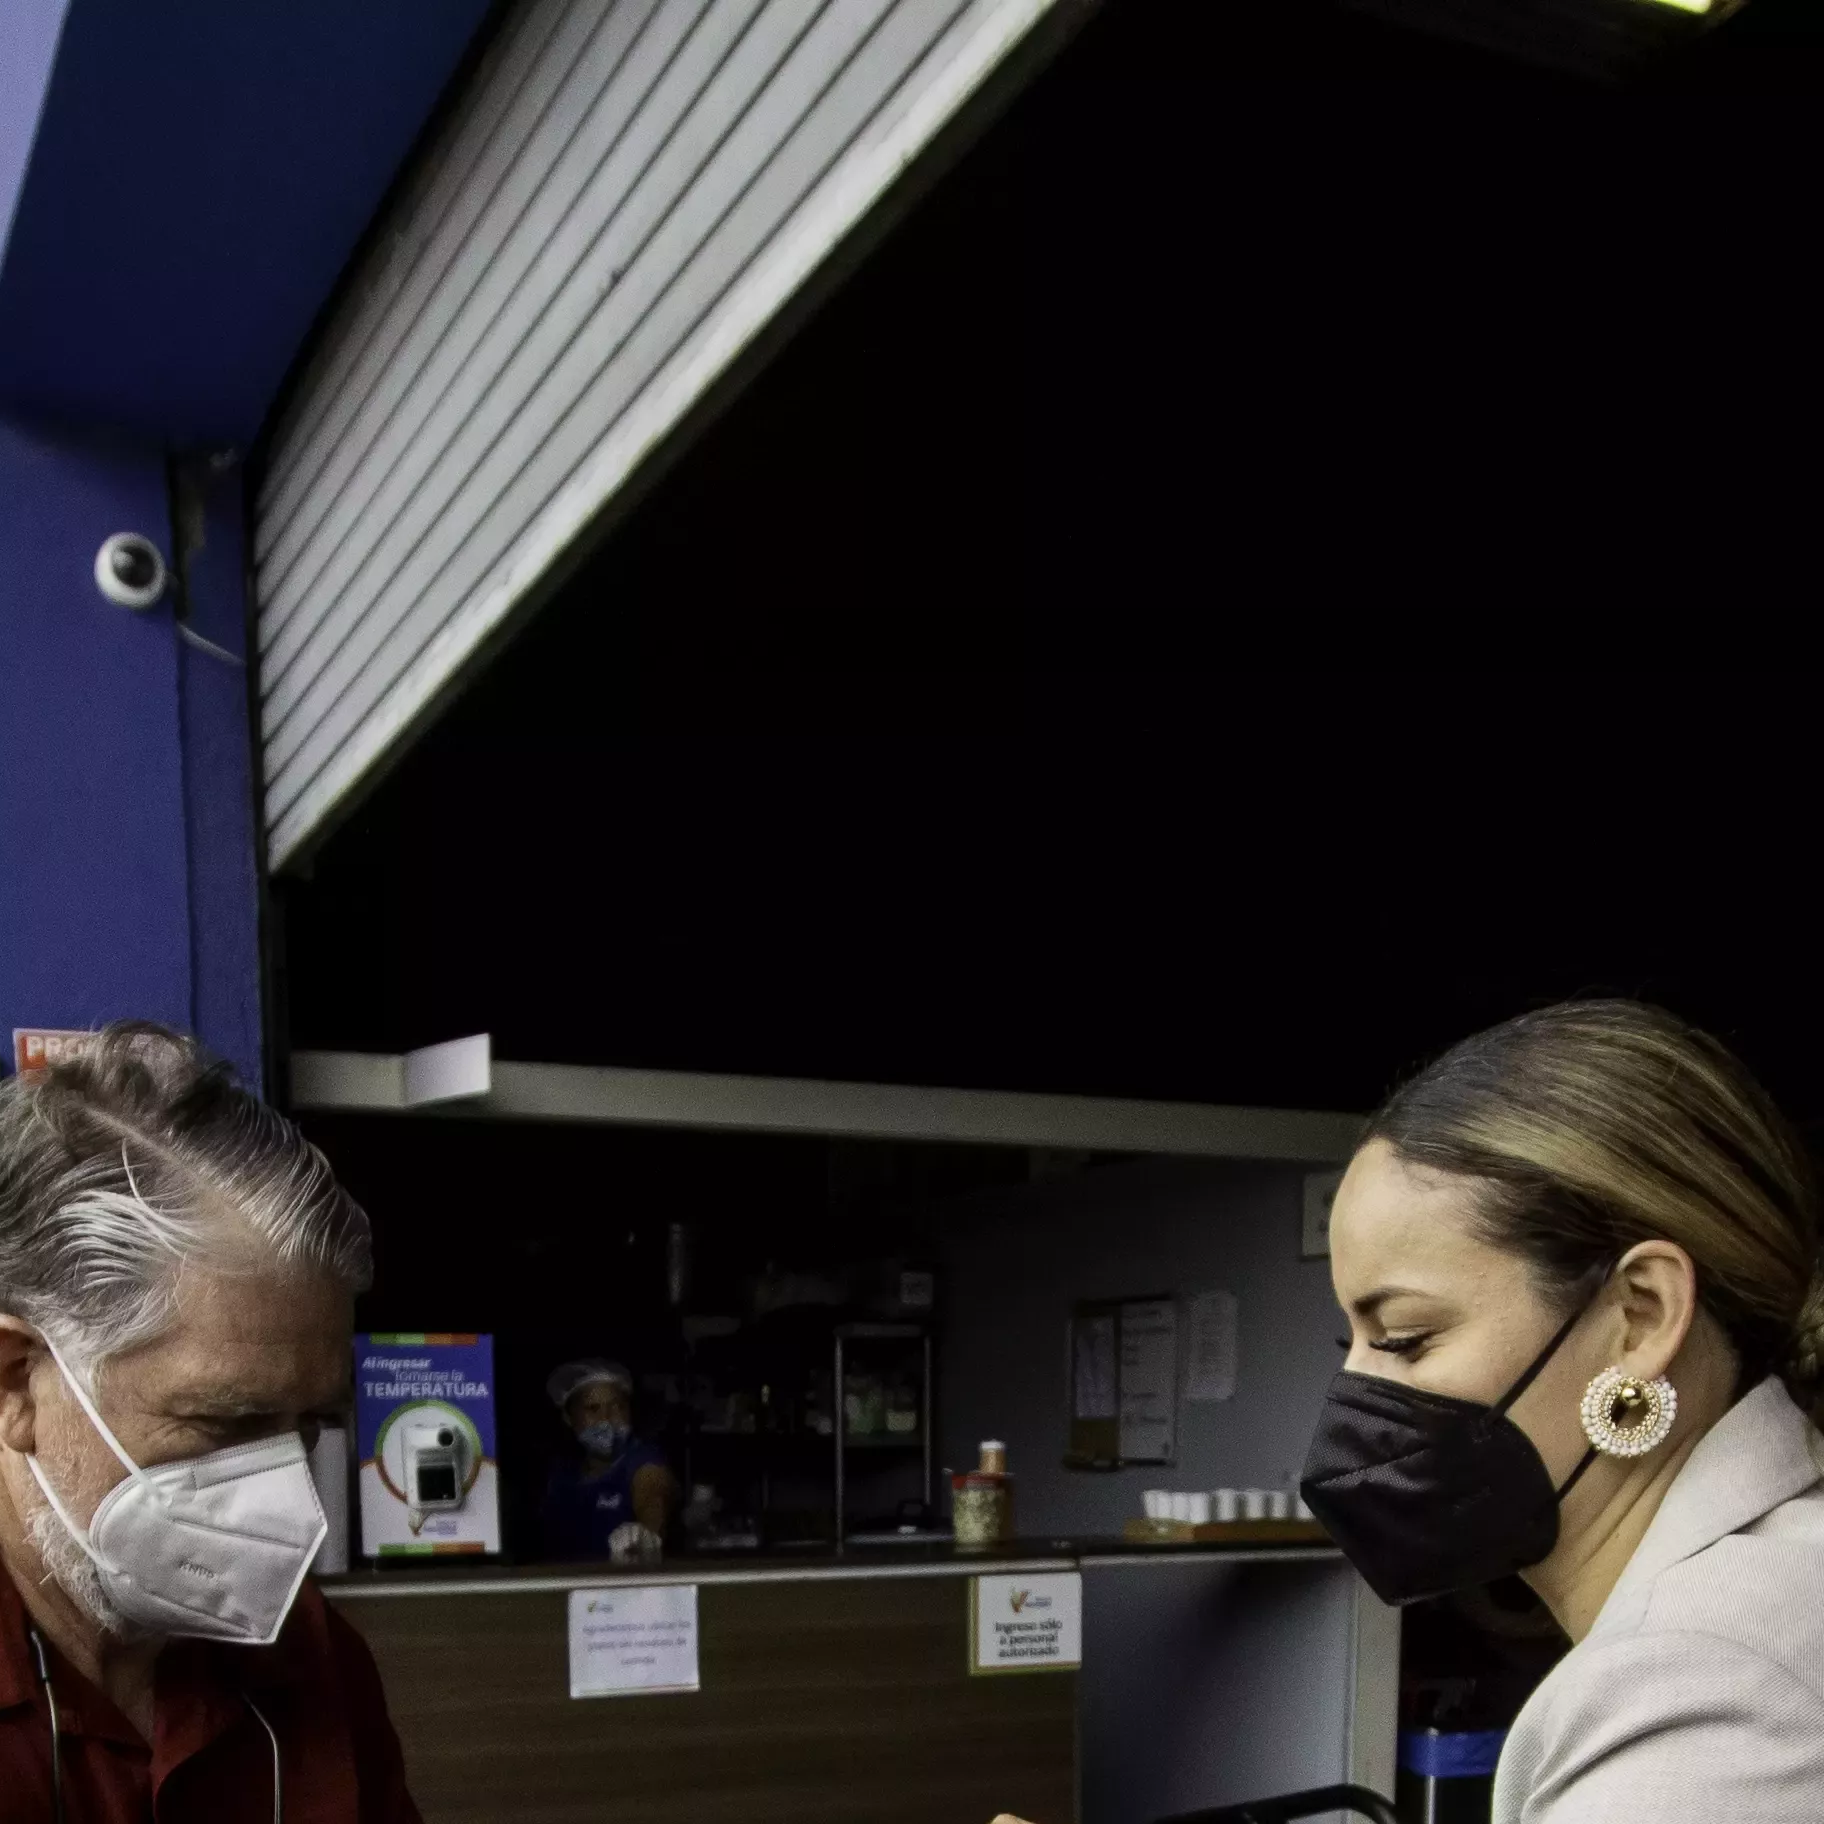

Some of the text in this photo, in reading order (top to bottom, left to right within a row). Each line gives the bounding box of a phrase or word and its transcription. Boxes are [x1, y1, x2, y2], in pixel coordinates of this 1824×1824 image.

[364, 1382, 489, 1398] TEMPERATURA
[995, 1622, 1037, 1634] Ingreso
[1009, 1632, 1058, 1646] personal
[998, 1646, 1059, 1658] autorizado
